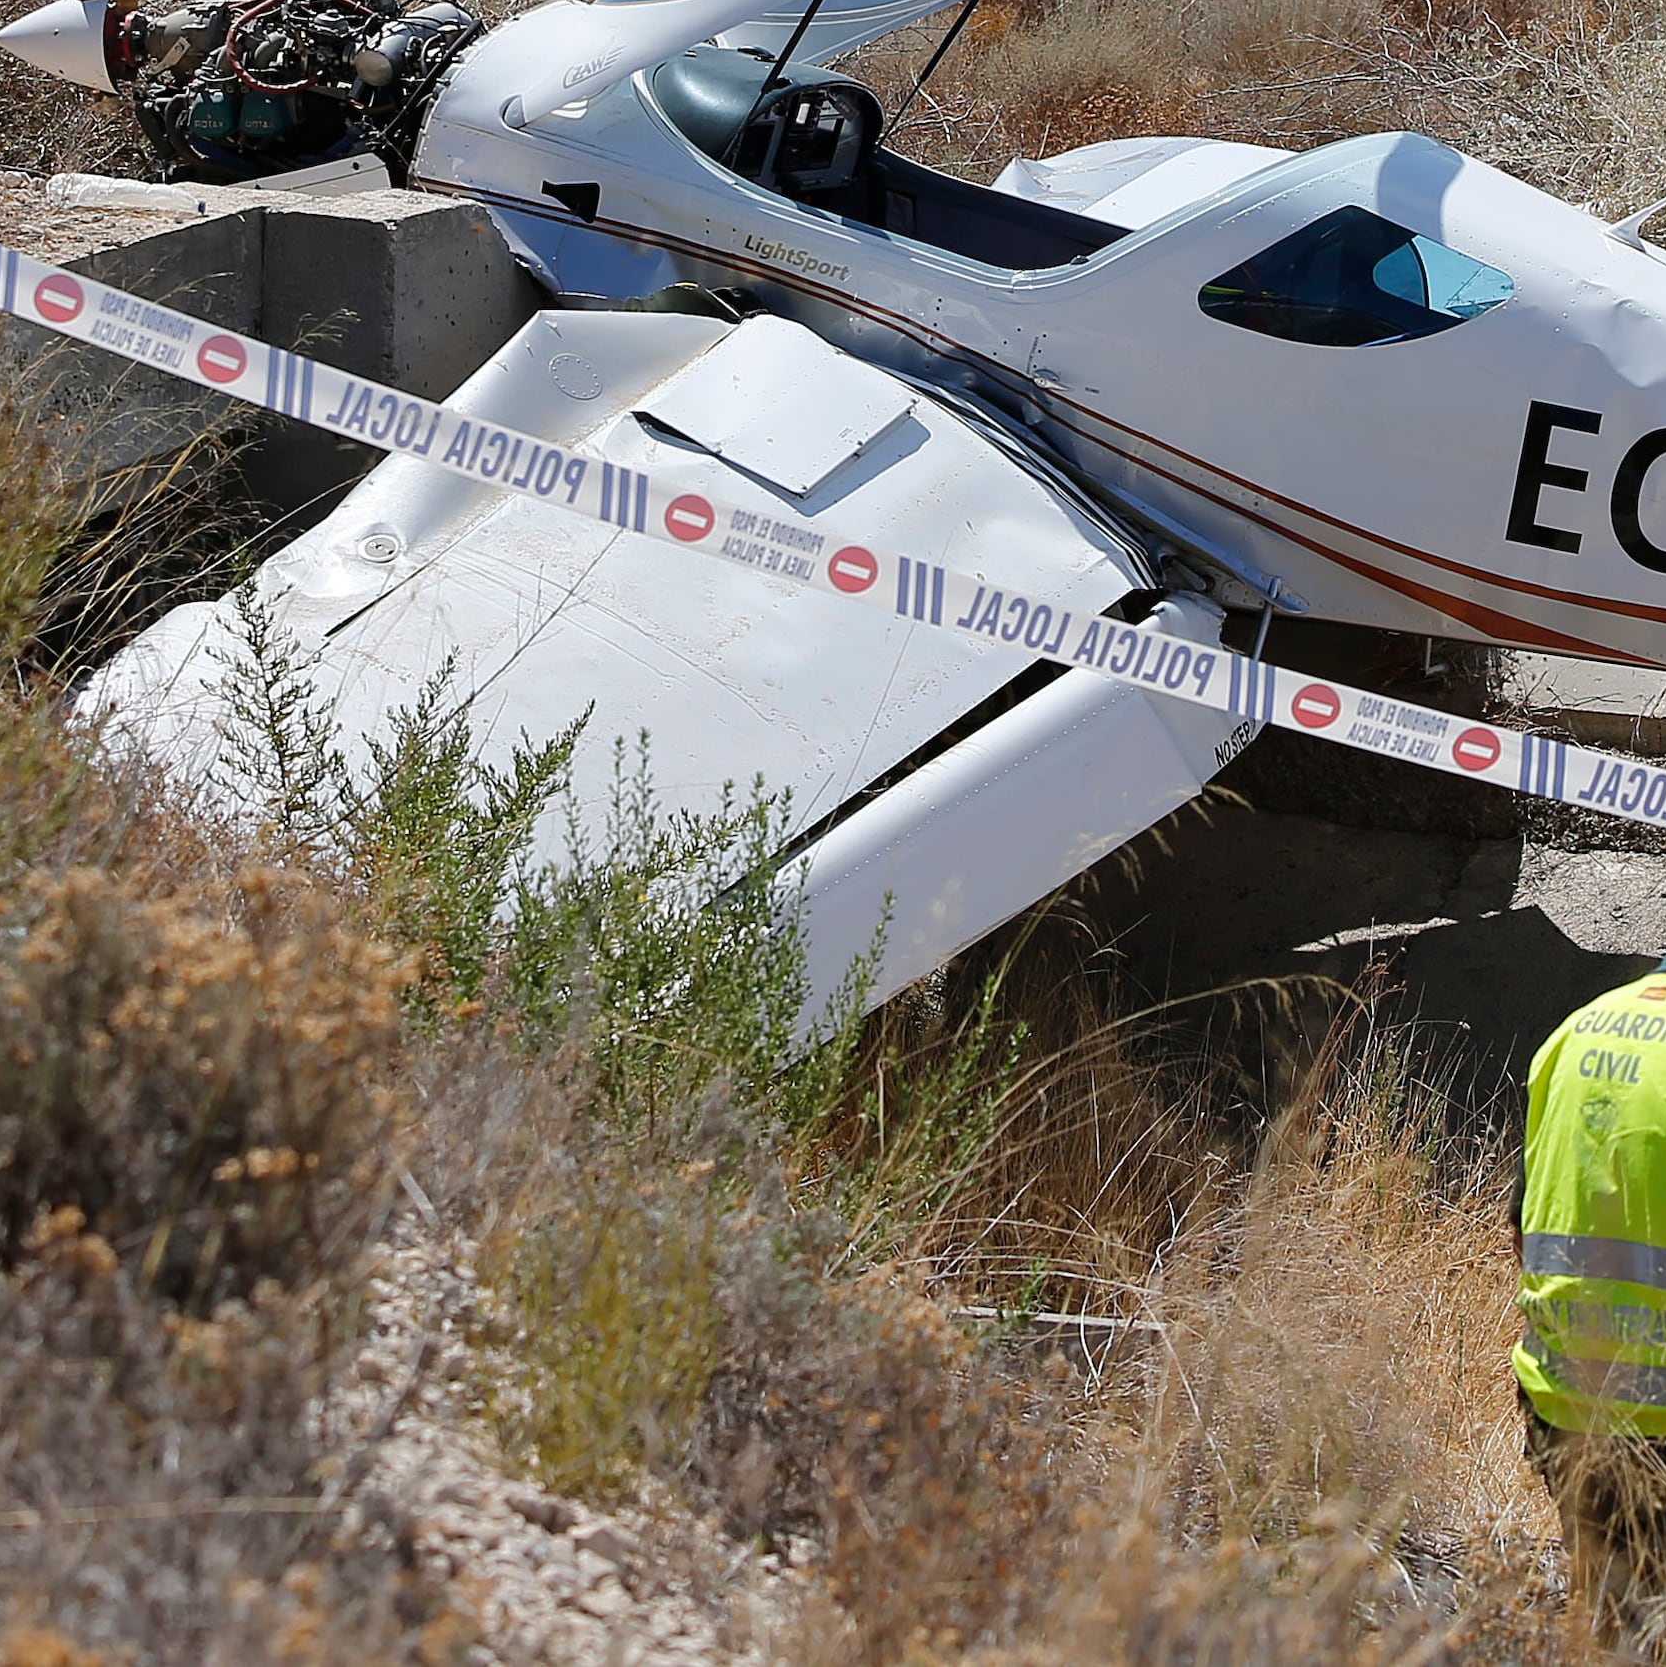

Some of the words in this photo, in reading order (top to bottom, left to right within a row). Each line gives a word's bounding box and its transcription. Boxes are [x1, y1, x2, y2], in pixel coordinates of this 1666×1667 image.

[744, 234, 850, 282] LightSport
[1214, 740, 1231, 768] NO
[1231, 720, 1251, 755] STEP
[1579, 1048, 1642, 1084] CIVIL
